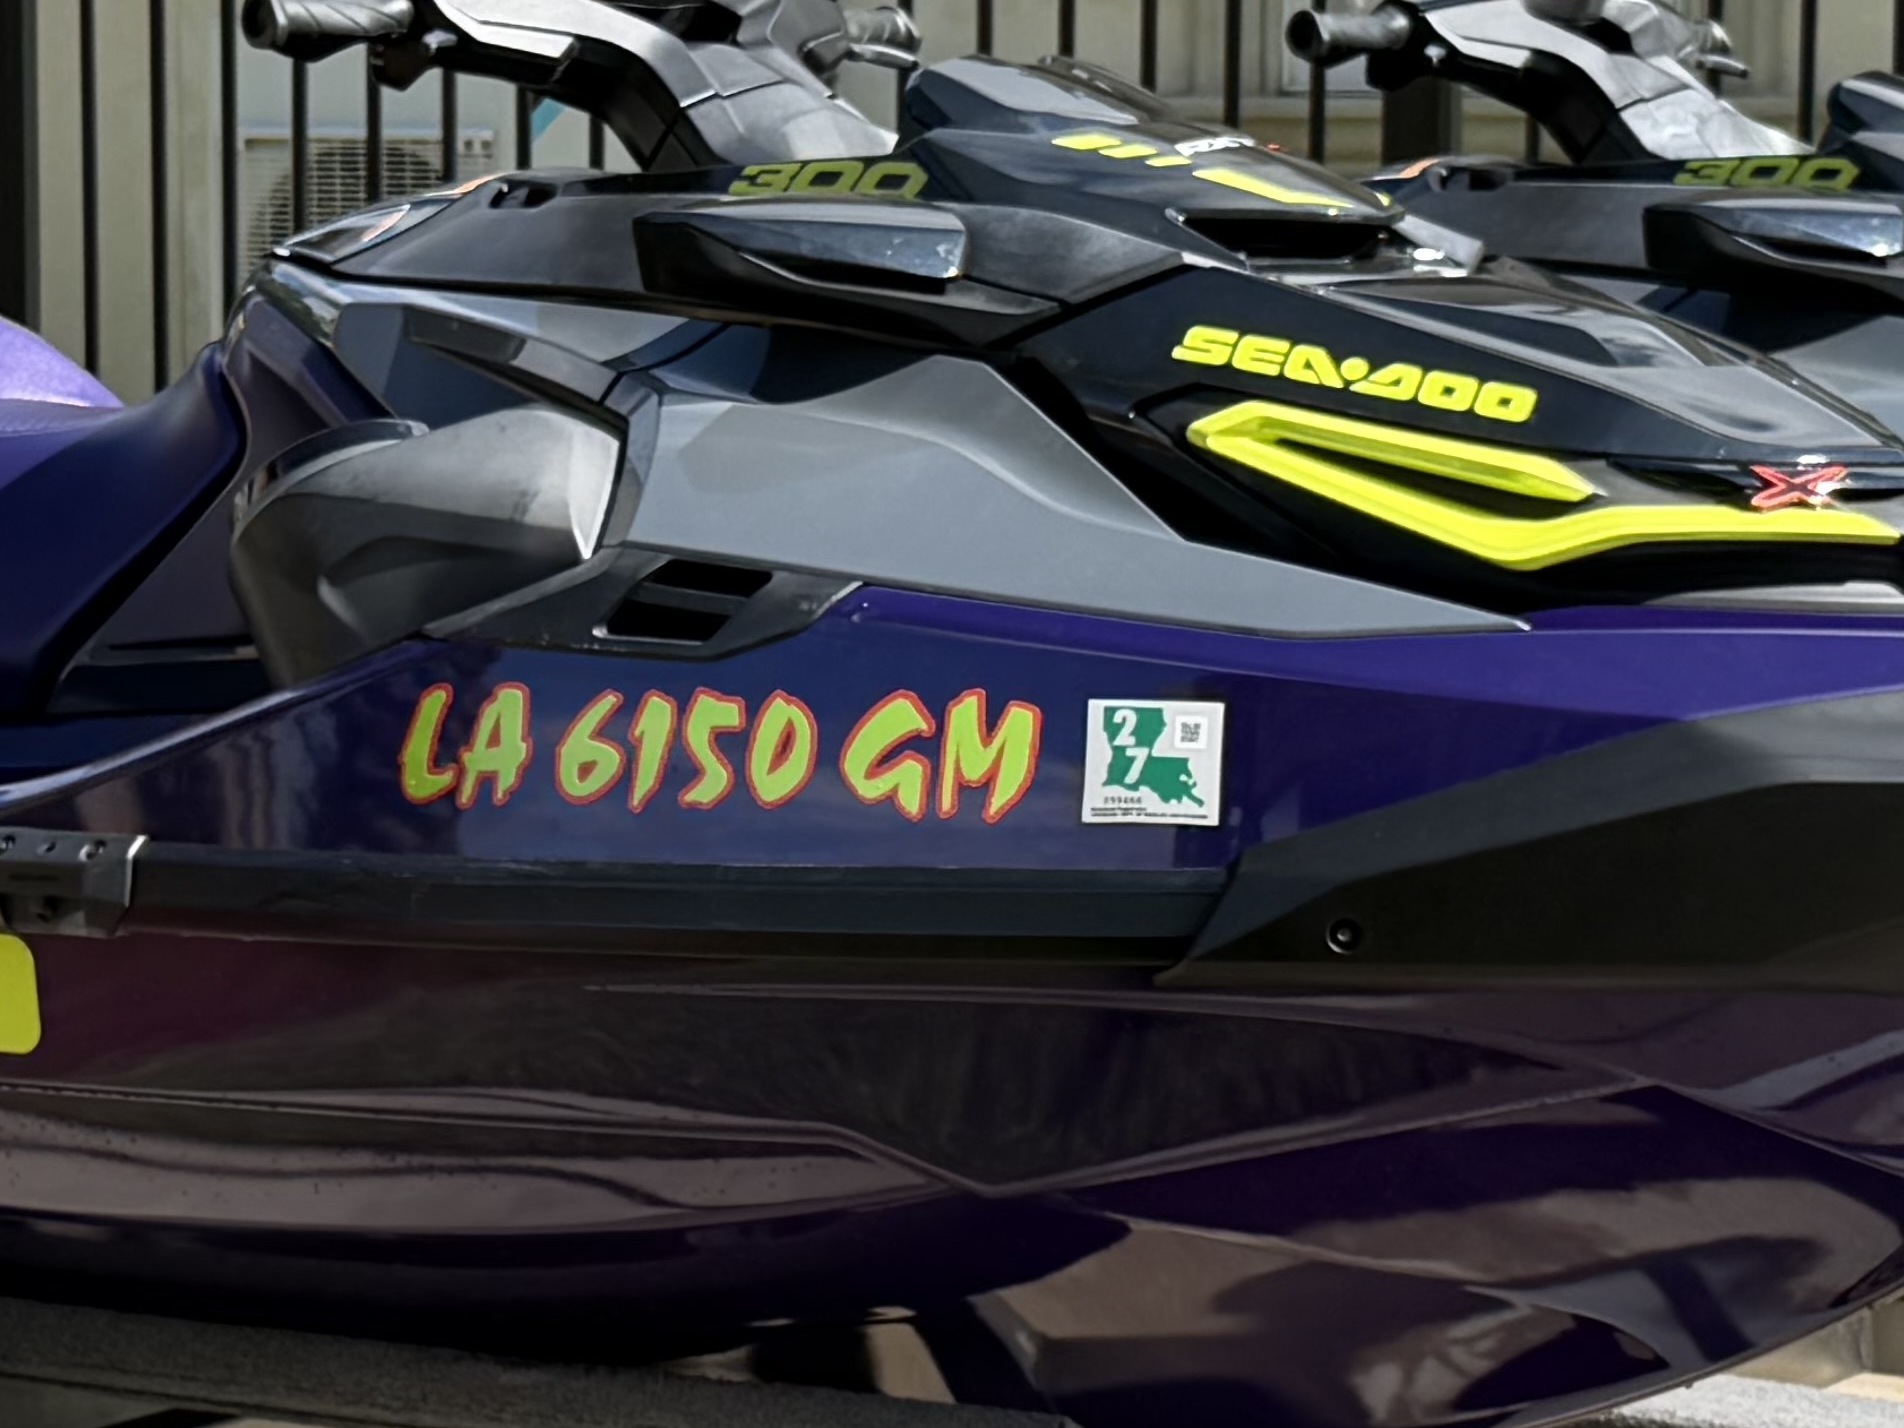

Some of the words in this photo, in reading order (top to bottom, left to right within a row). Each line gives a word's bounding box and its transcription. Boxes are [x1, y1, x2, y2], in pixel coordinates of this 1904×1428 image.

[728, 160, 929, 201] 300
[1673, 157, 1861, 192] 300
[401, 682, 532, 809] LA
[555, 686, 817, 812] 6150
[839, 687, 1042, 824] GM
